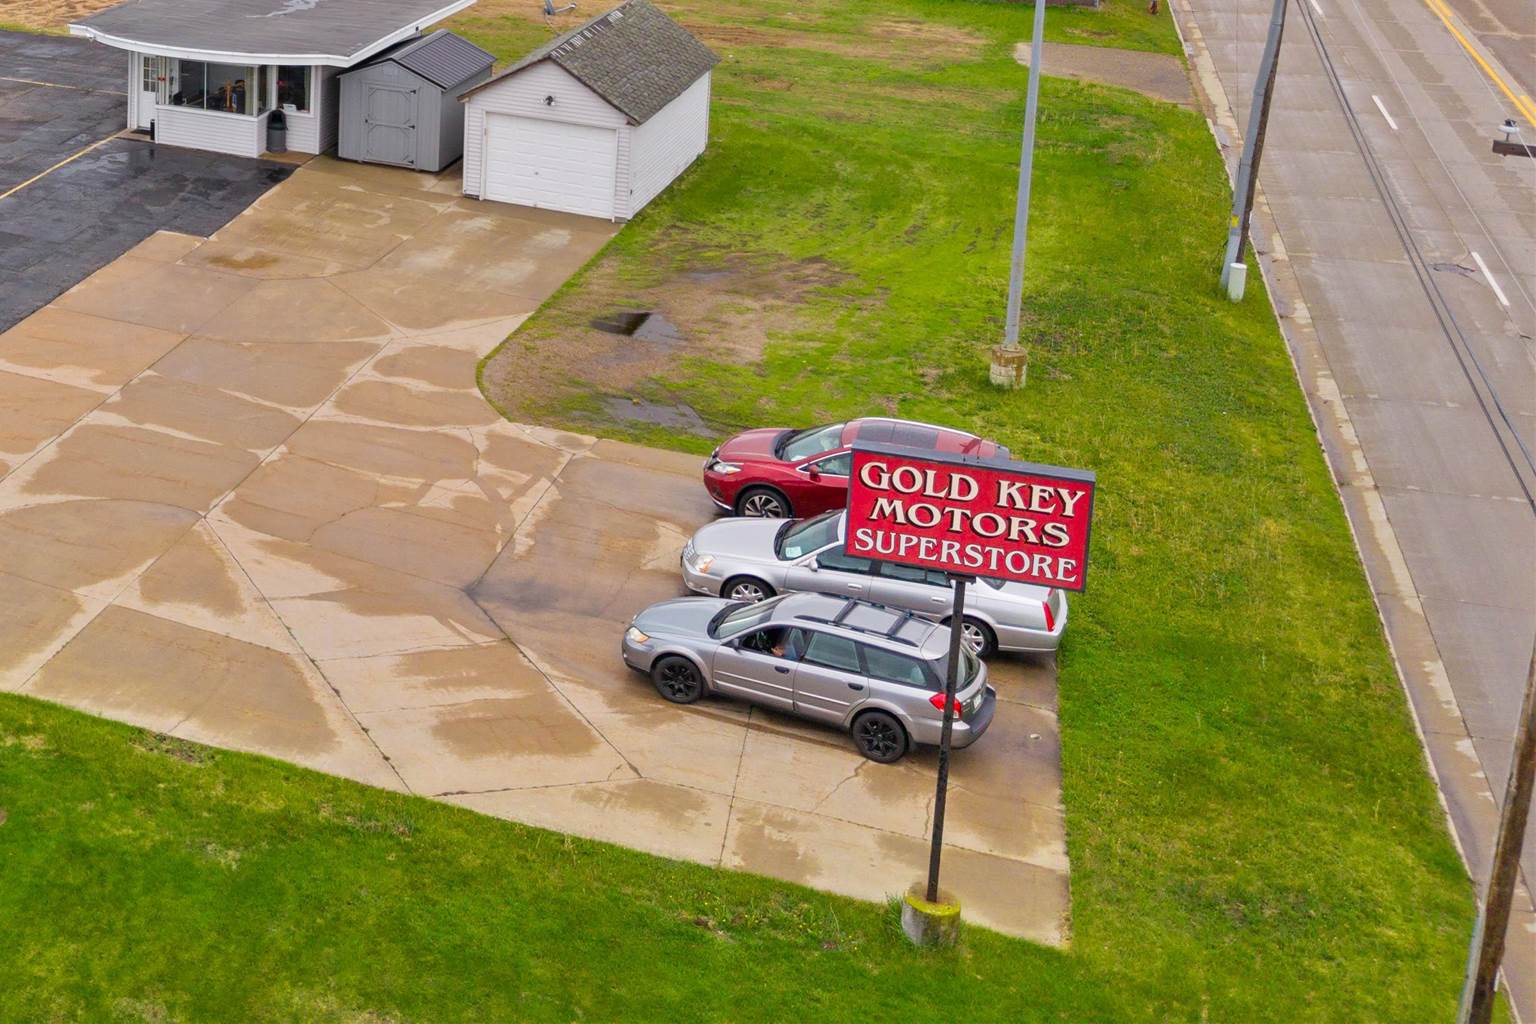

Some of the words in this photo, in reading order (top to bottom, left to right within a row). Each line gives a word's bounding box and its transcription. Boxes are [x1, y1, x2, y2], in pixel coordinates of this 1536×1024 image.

[860, 461, 980, 503] GOLD
[995, 479, 1086, 518] KEY
[868, 496, 1071, 548] MOTORS
[854, 527, 1078, 583] SUPERSTORE
